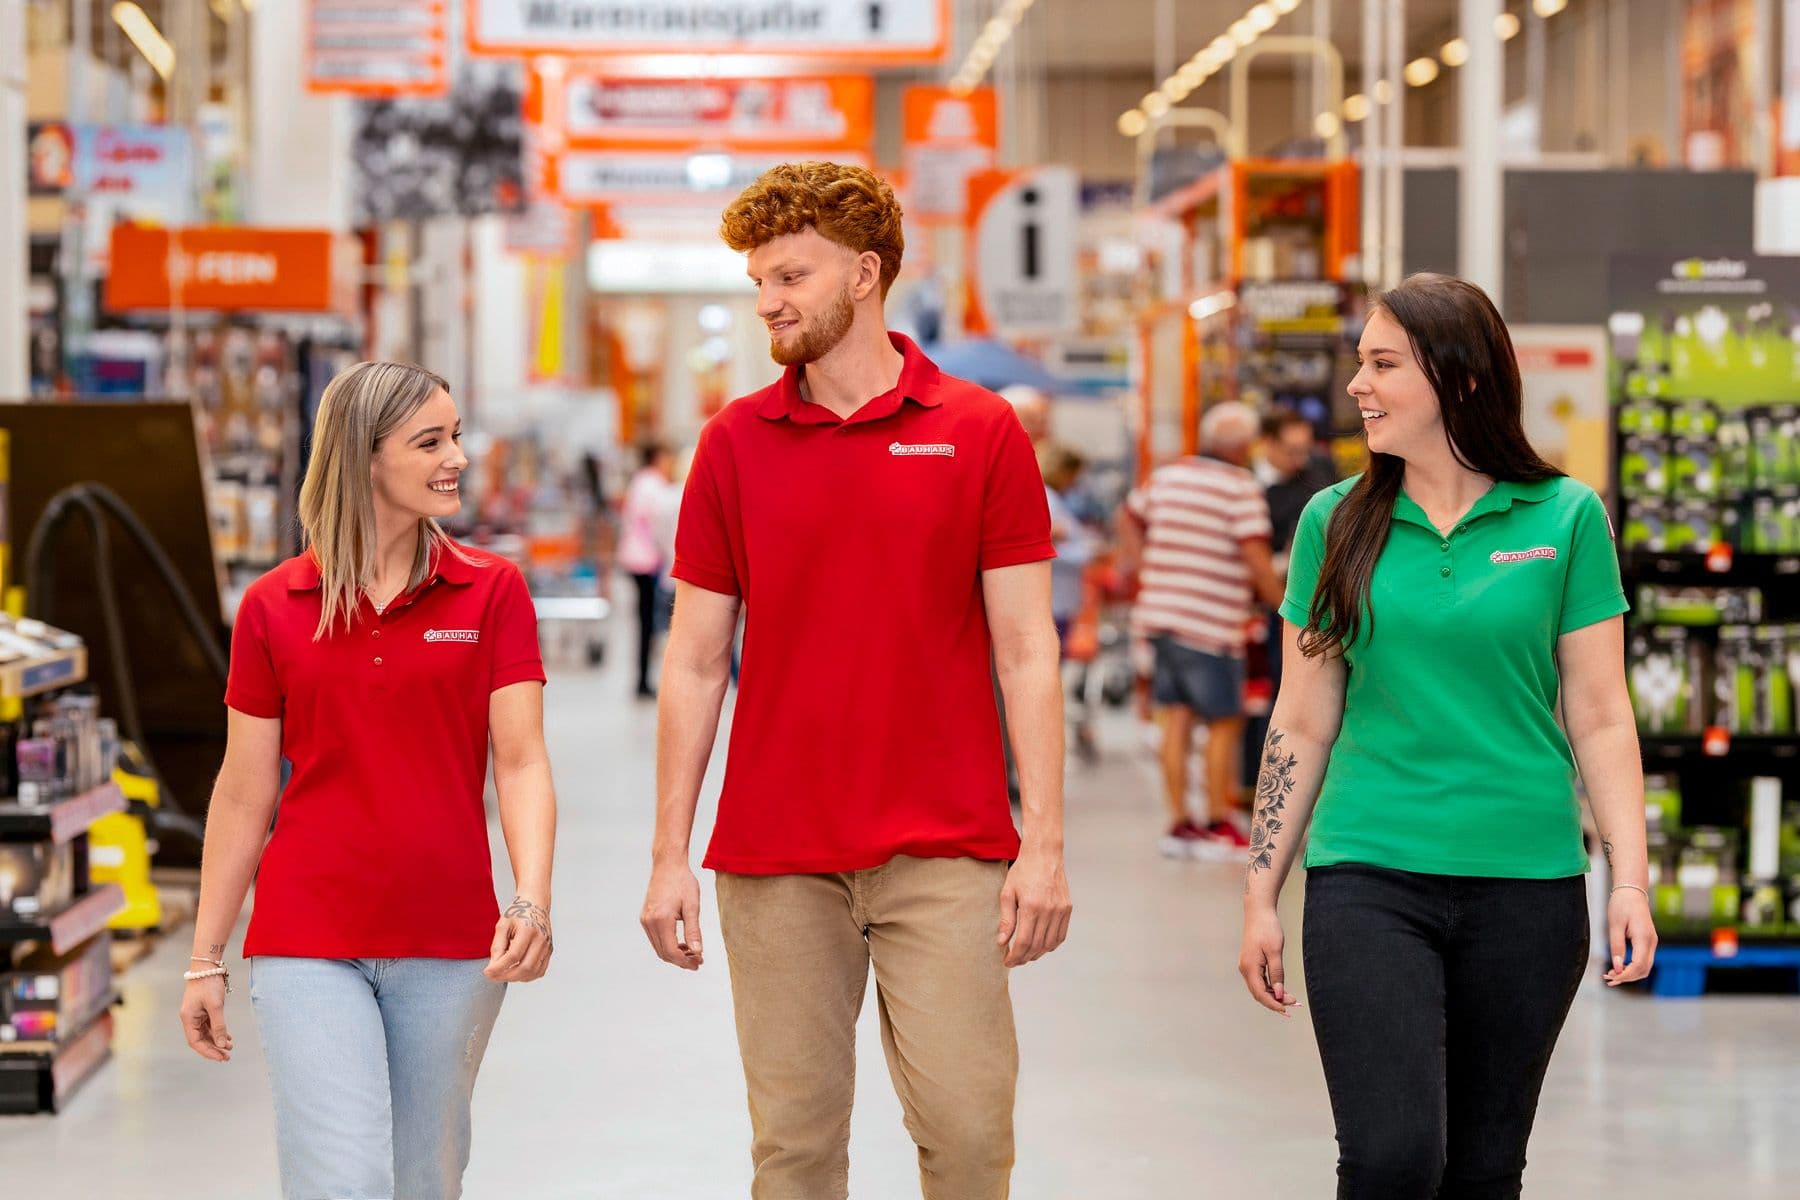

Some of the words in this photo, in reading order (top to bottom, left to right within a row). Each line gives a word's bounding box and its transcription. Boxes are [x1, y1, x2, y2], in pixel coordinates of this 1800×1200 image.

[900, 445, 954, 455] BAUHAUS
[1502, 548, 1555, 561] BAUHAUS
[436, 631, 479, 640] BAUHAU
